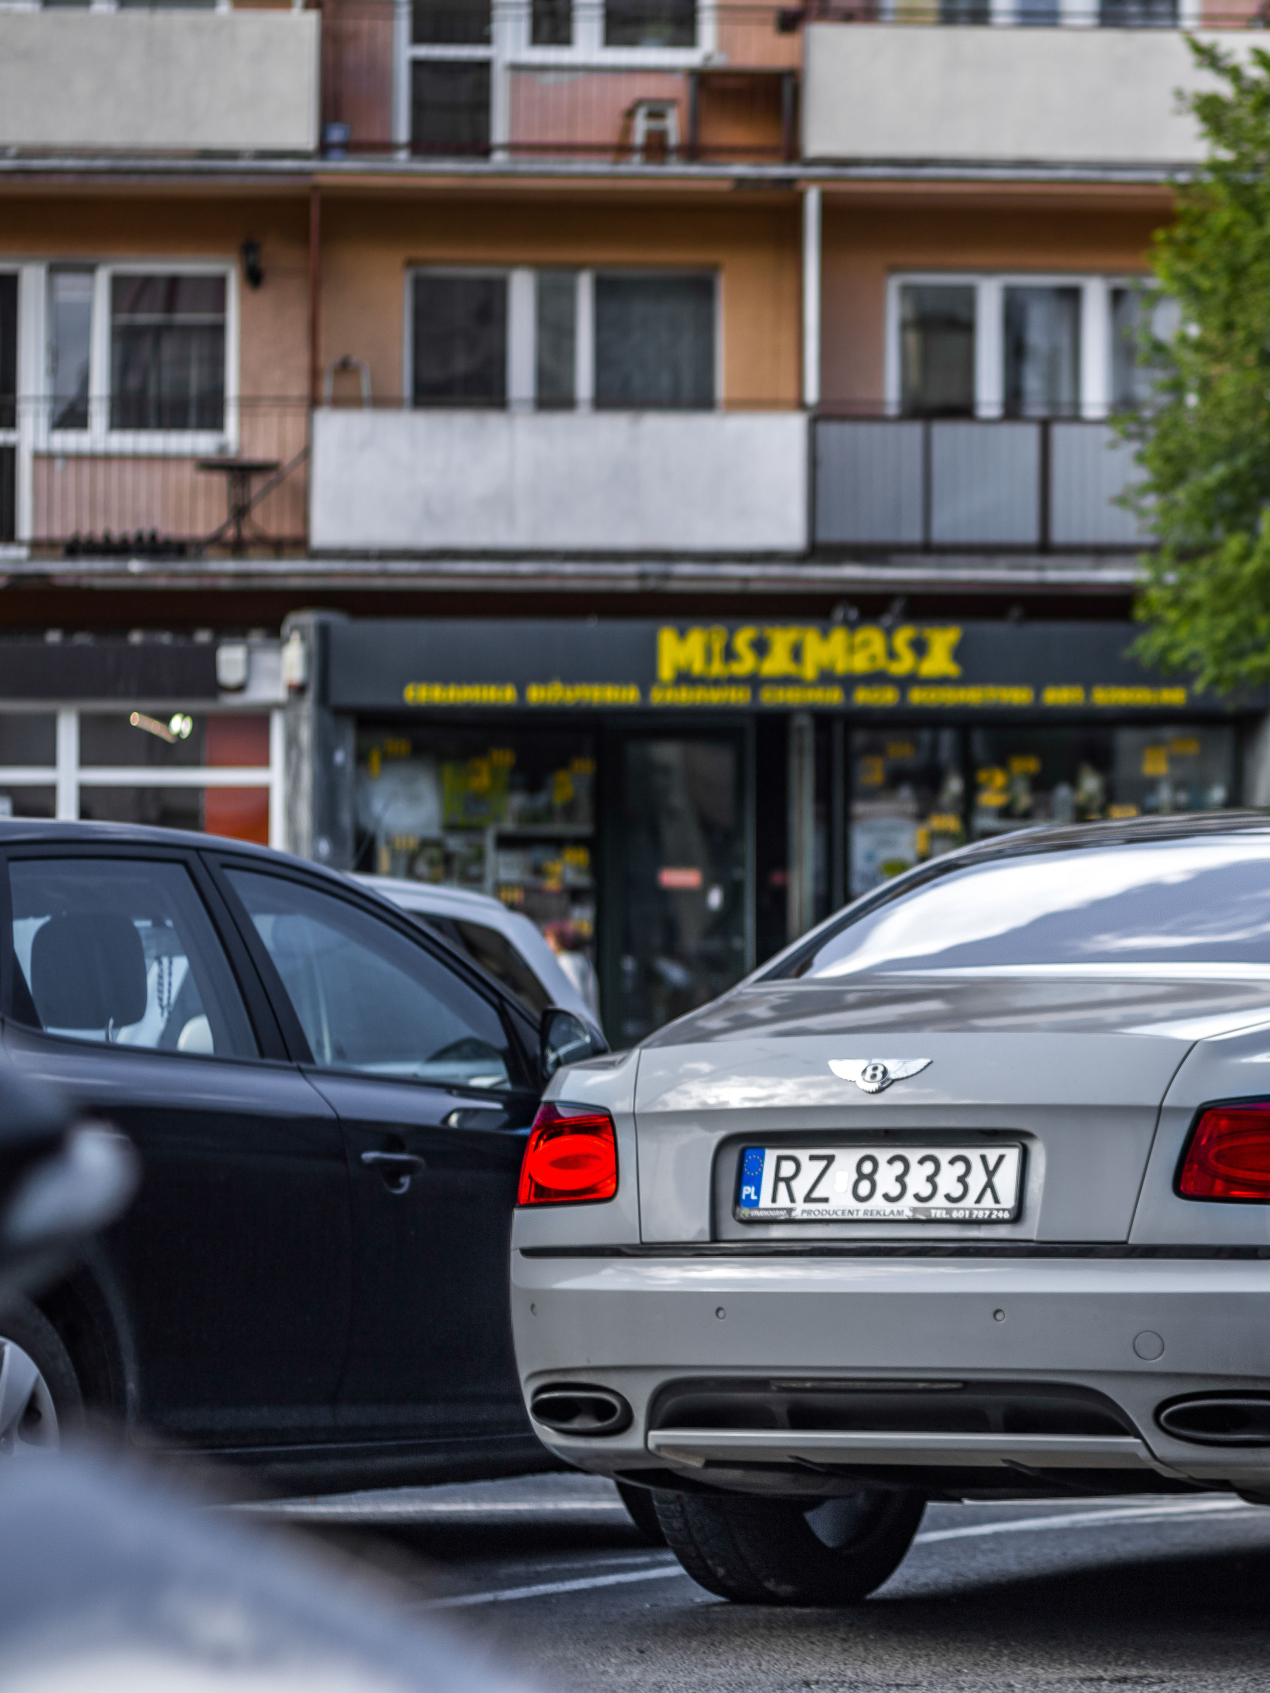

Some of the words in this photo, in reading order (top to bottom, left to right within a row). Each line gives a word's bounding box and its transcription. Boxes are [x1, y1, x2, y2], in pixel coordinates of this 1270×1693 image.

[404, 683, 517, 706] CERAMIKA
[771, 1154, 836, 1204] RZ
[851, 1154, 1006, 1204] 8333X
[741, 1186, 757, 1200] PL
[801, 1208, 860, 1217] PRODUCENT
[863, 1208, 905, 1217] REKLAM
[930, 1209, 950, 1218] TEL.
[952, 1209, 969, 1218] 601
[972, 1209, 989, 1218] 787
[991, 1210, 1010, 1219] 246
